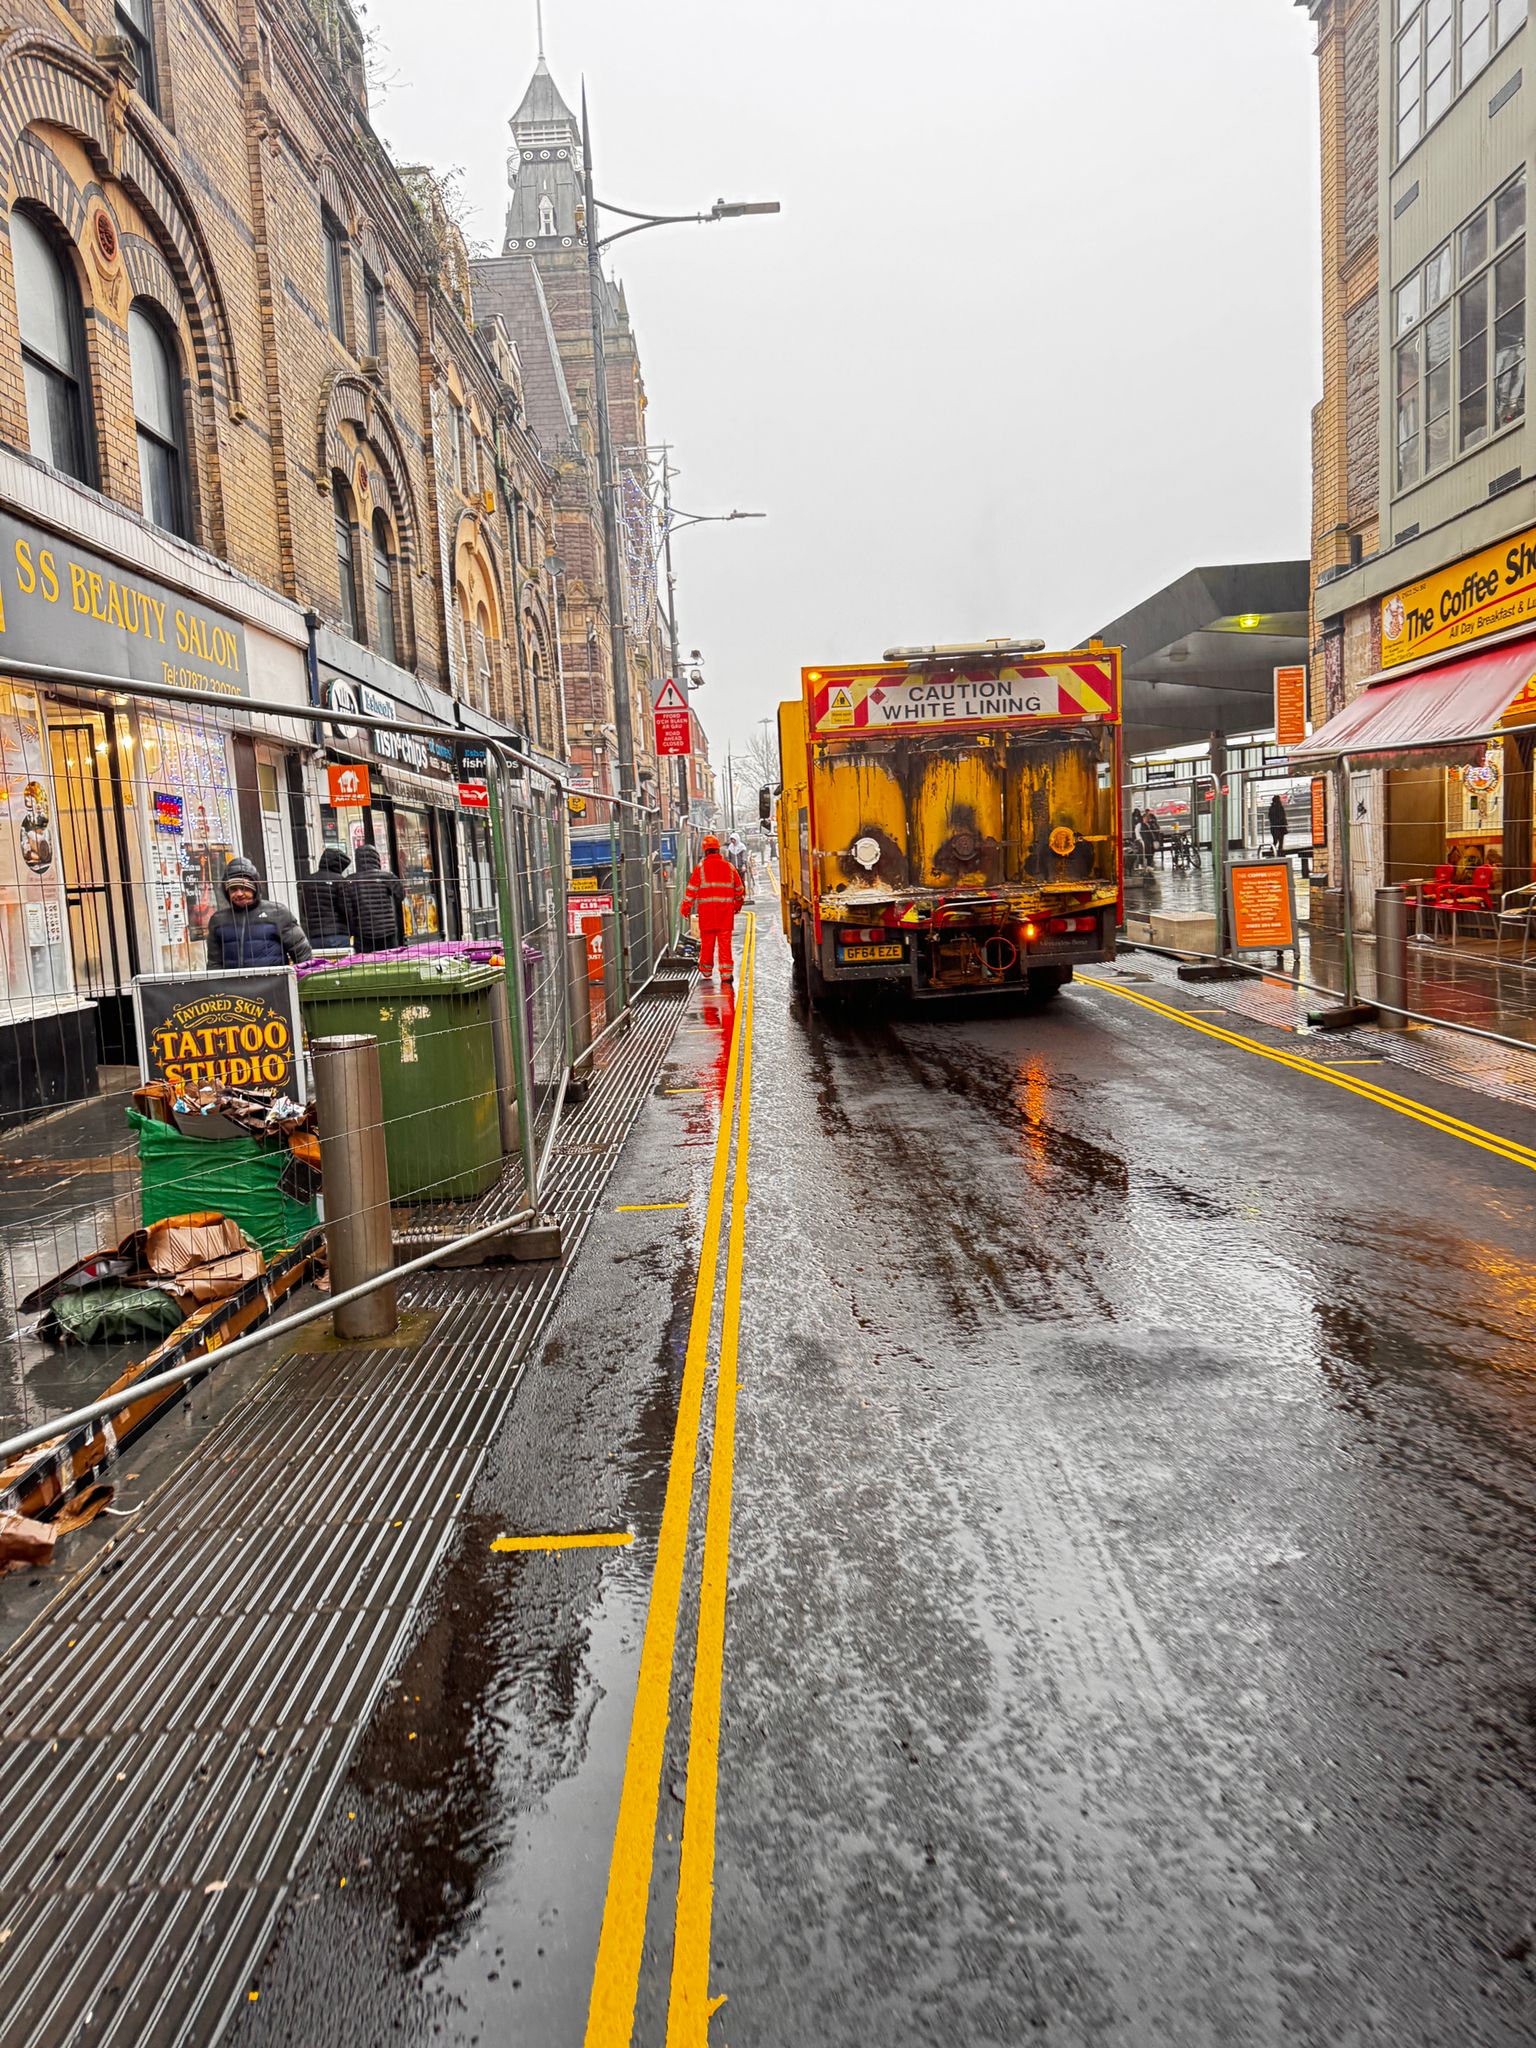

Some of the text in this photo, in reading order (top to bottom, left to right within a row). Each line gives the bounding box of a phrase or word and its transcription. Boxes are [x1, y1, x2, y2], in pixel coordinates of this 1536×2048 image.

[68, 561, 167, 645] BEAUTY
[175, 608, 240, 673] SALON
[1406, 607, 1435, 643] The
[1440, 569, 1499, 622] Coffee
[1460, 622, 1475, 635] Day
[1477, 605, 1516, 629] Breakfast
[162, 661, 179, 687] Tel:
[908, 681, 1012, 702] CAUTION
[882, 697, 1041, 721] WHITE LINING
[847, 945, 900, 959] GF64 EZE
[173, 999, 265, 1025] TAYLORED SKIN
[156, 1021, 288, 1061] TATTOO
[165, 1053, 287, 1091] STUDIO
